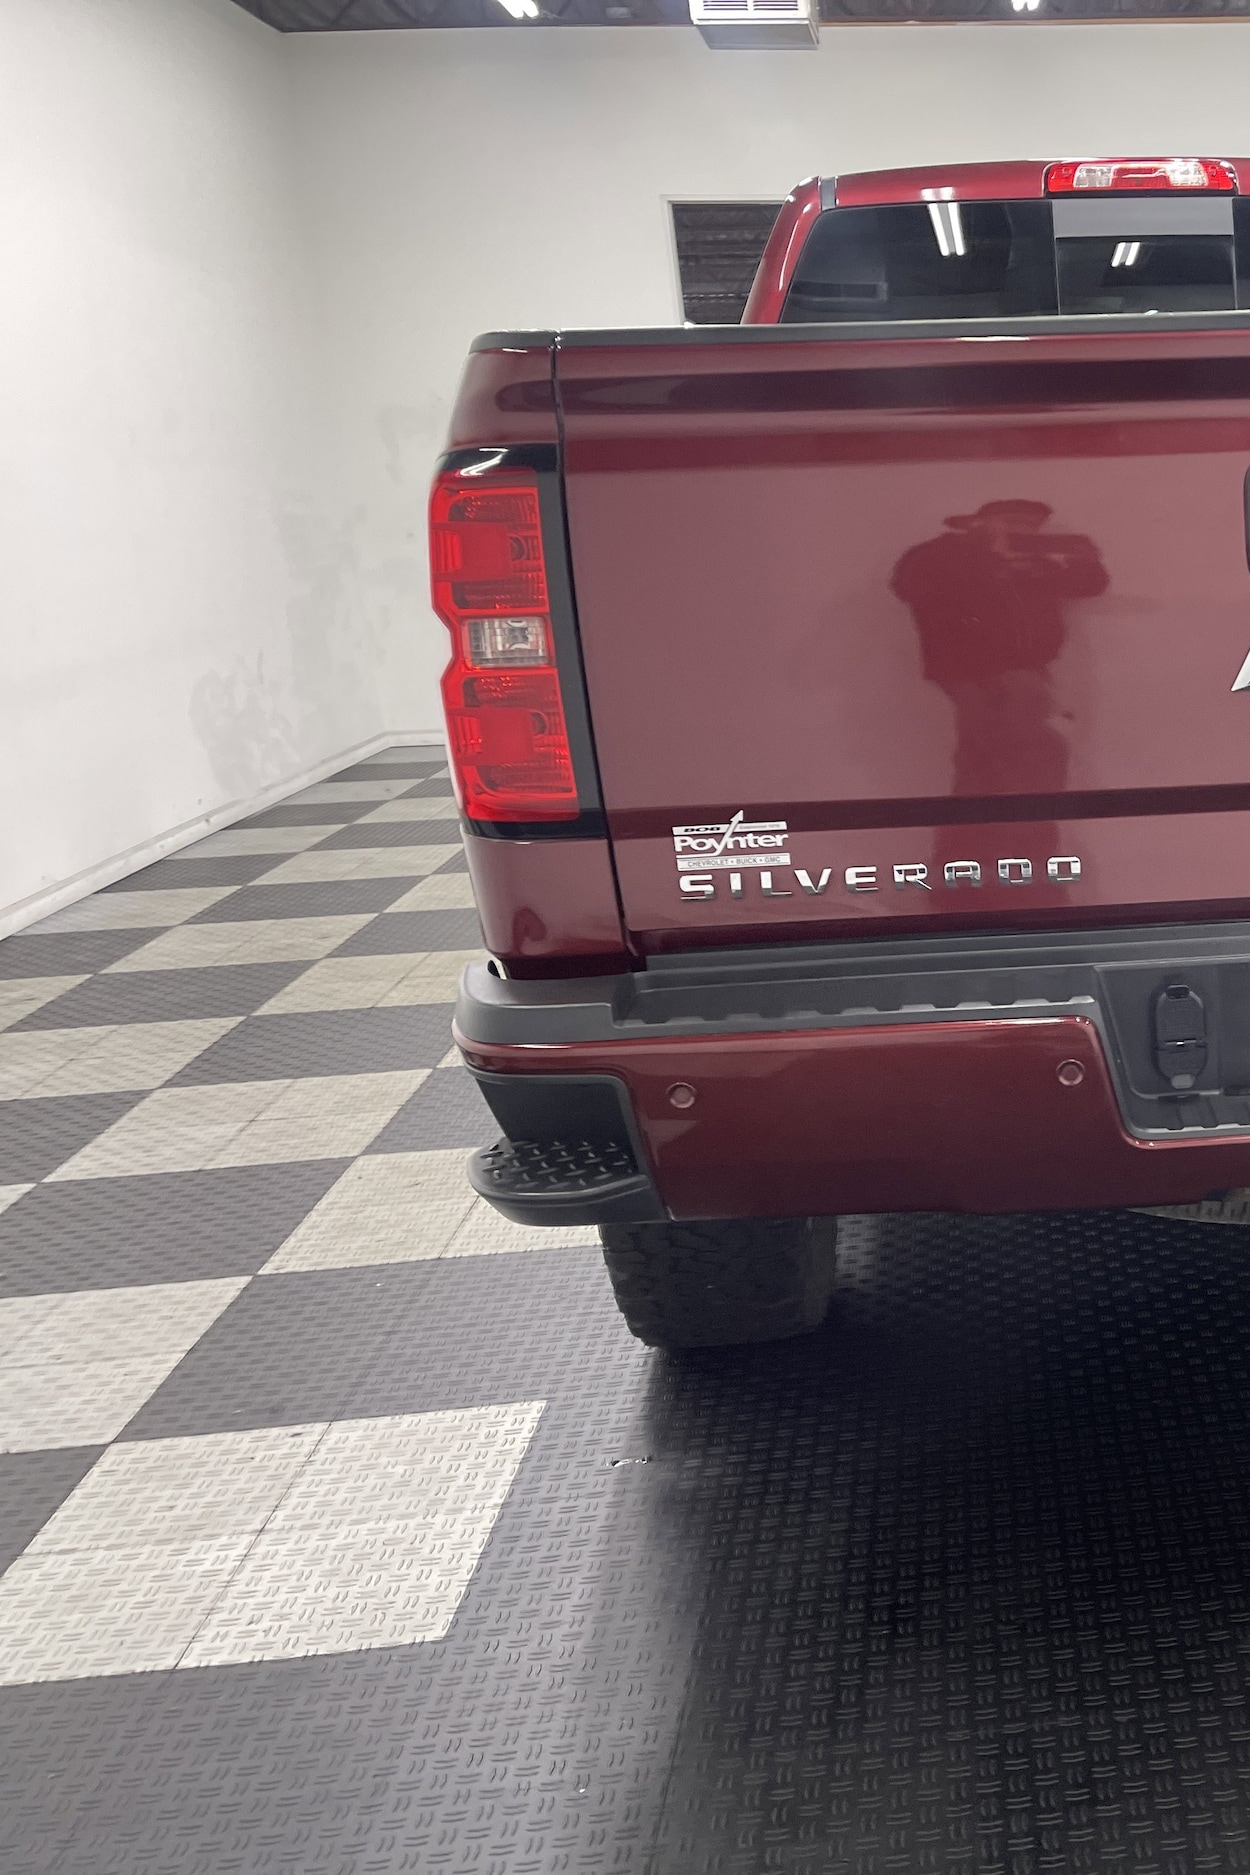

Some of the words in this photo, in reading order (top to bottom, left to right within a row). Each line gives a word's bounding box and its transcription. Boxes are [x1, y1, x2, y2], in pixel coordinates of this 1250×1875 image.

[674, 832, 789, 857] Poynter
[687, 859, 729, 868] CHEVROLET
[764, 856, 781, 864] GMC
[678, 855, 1083, 901] SILVERADO
